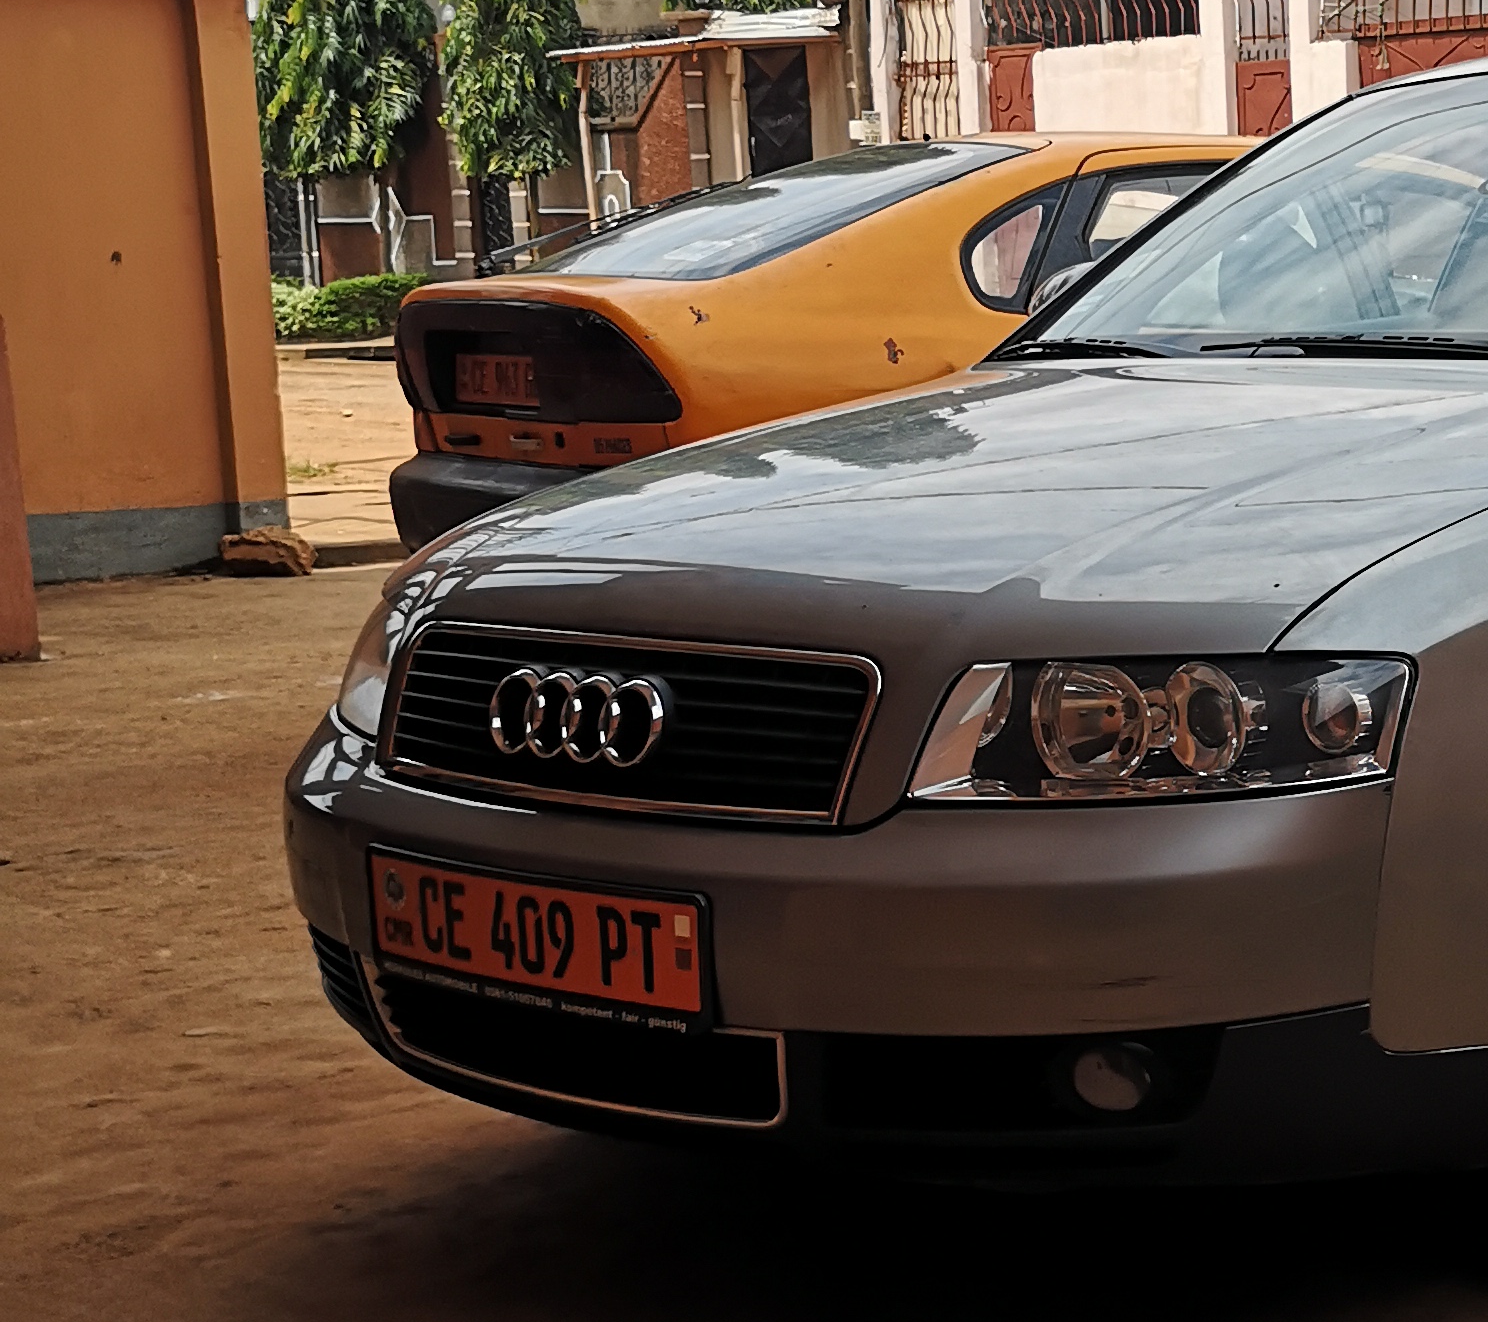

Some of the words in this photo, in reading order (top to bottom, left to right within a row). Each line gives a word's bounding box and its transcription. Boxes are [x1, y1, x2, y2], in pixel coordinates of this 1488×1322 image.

[418, 875, 472, 961] CE
[491, 890, 574, 979] 409
[596, 904, 661, 994] PT
[561, 1001, 613, 1019] kompetent
[621, 1011, 640, 1023] fair
[647, 1017, 687, 1033] günstig
